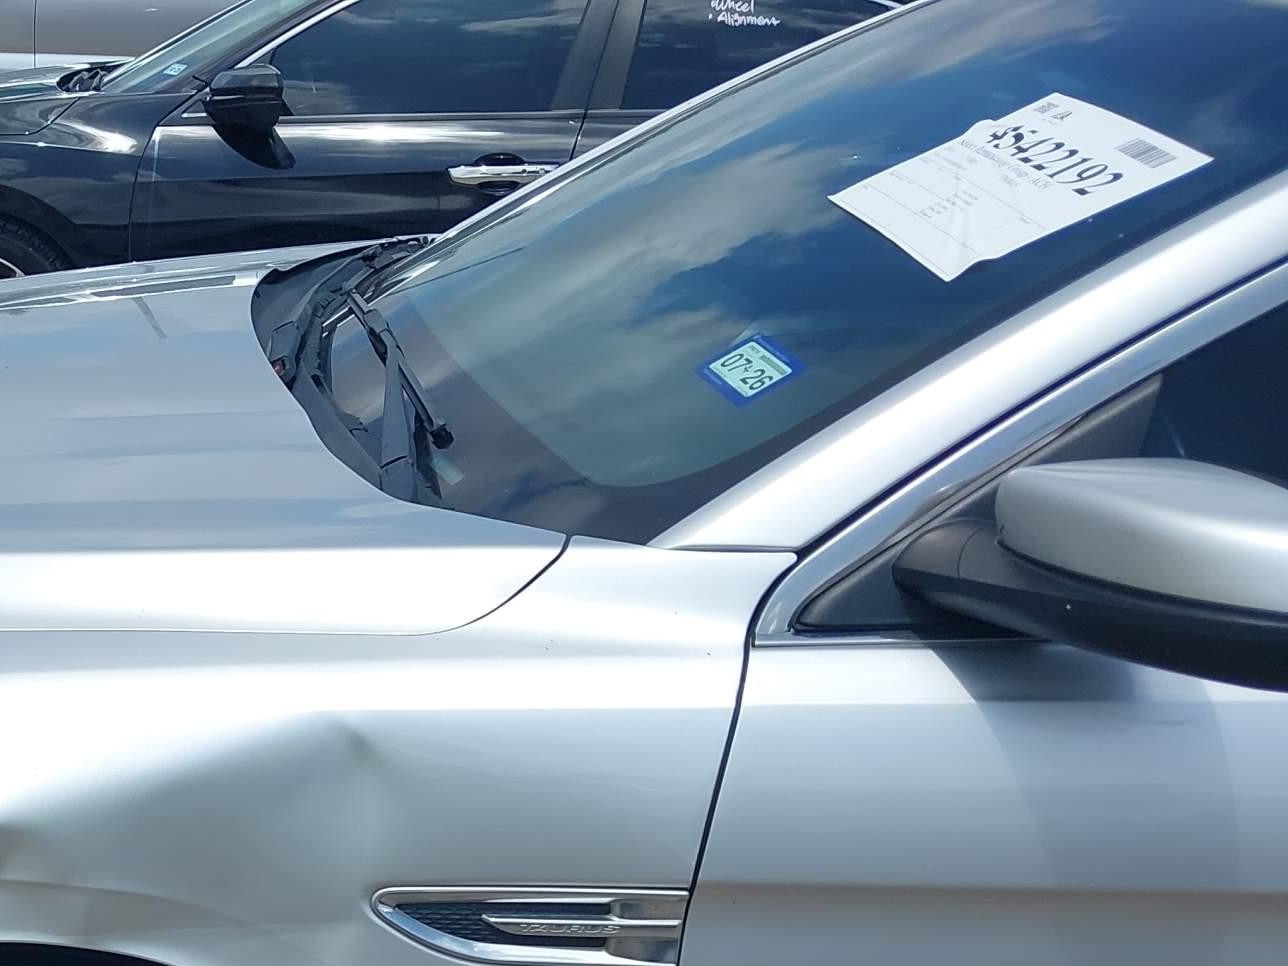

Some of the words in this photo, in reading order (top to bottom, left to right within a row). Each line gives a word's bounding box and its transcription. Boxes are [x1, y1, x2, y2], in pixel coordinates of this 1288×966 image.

[986, 125, 1124, 196] 45422192
[720, 353, 753, 372] 07
[740, 369, 774, 391] 26
[520, 924, 620, 934] TAURUS
